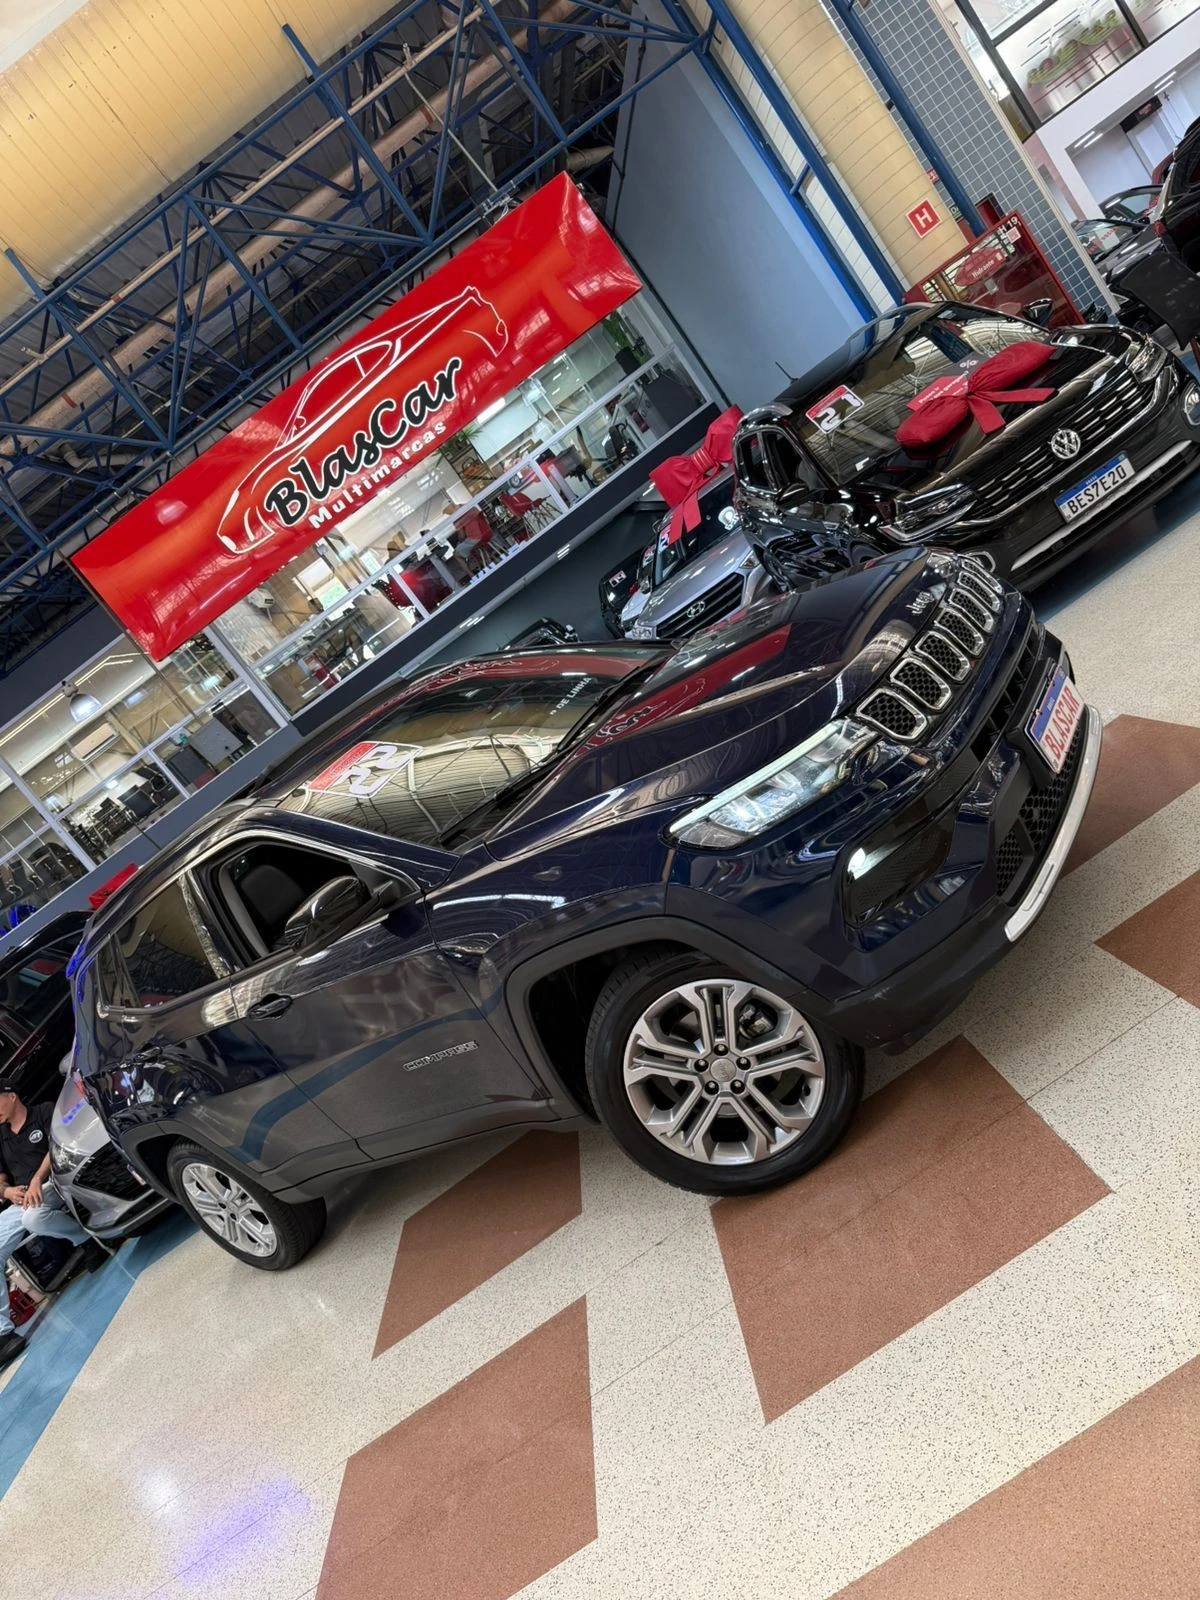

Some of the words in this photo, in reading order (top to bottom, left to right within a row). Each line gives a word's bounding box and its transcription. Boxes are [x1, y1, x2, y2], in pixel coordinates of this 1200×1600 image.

[915, 208, 932, 228] H
[816, 391, 861, 431] 21
[264, 357, 462, 526] BlasCar
[308, 421, 446, 528] Multimarcas
[1066, 465, 1127, 514] BES7E20
[905, 591, 934, 616] Jeep
[556, 698, 570, 709] DE
[566, 677, 592, 698] LINHA
[1044, 685, 1080, 761] BLASCAR
[334, 744, 412, 796] 22
[402, 1040, 479, 1071] COMPASS
